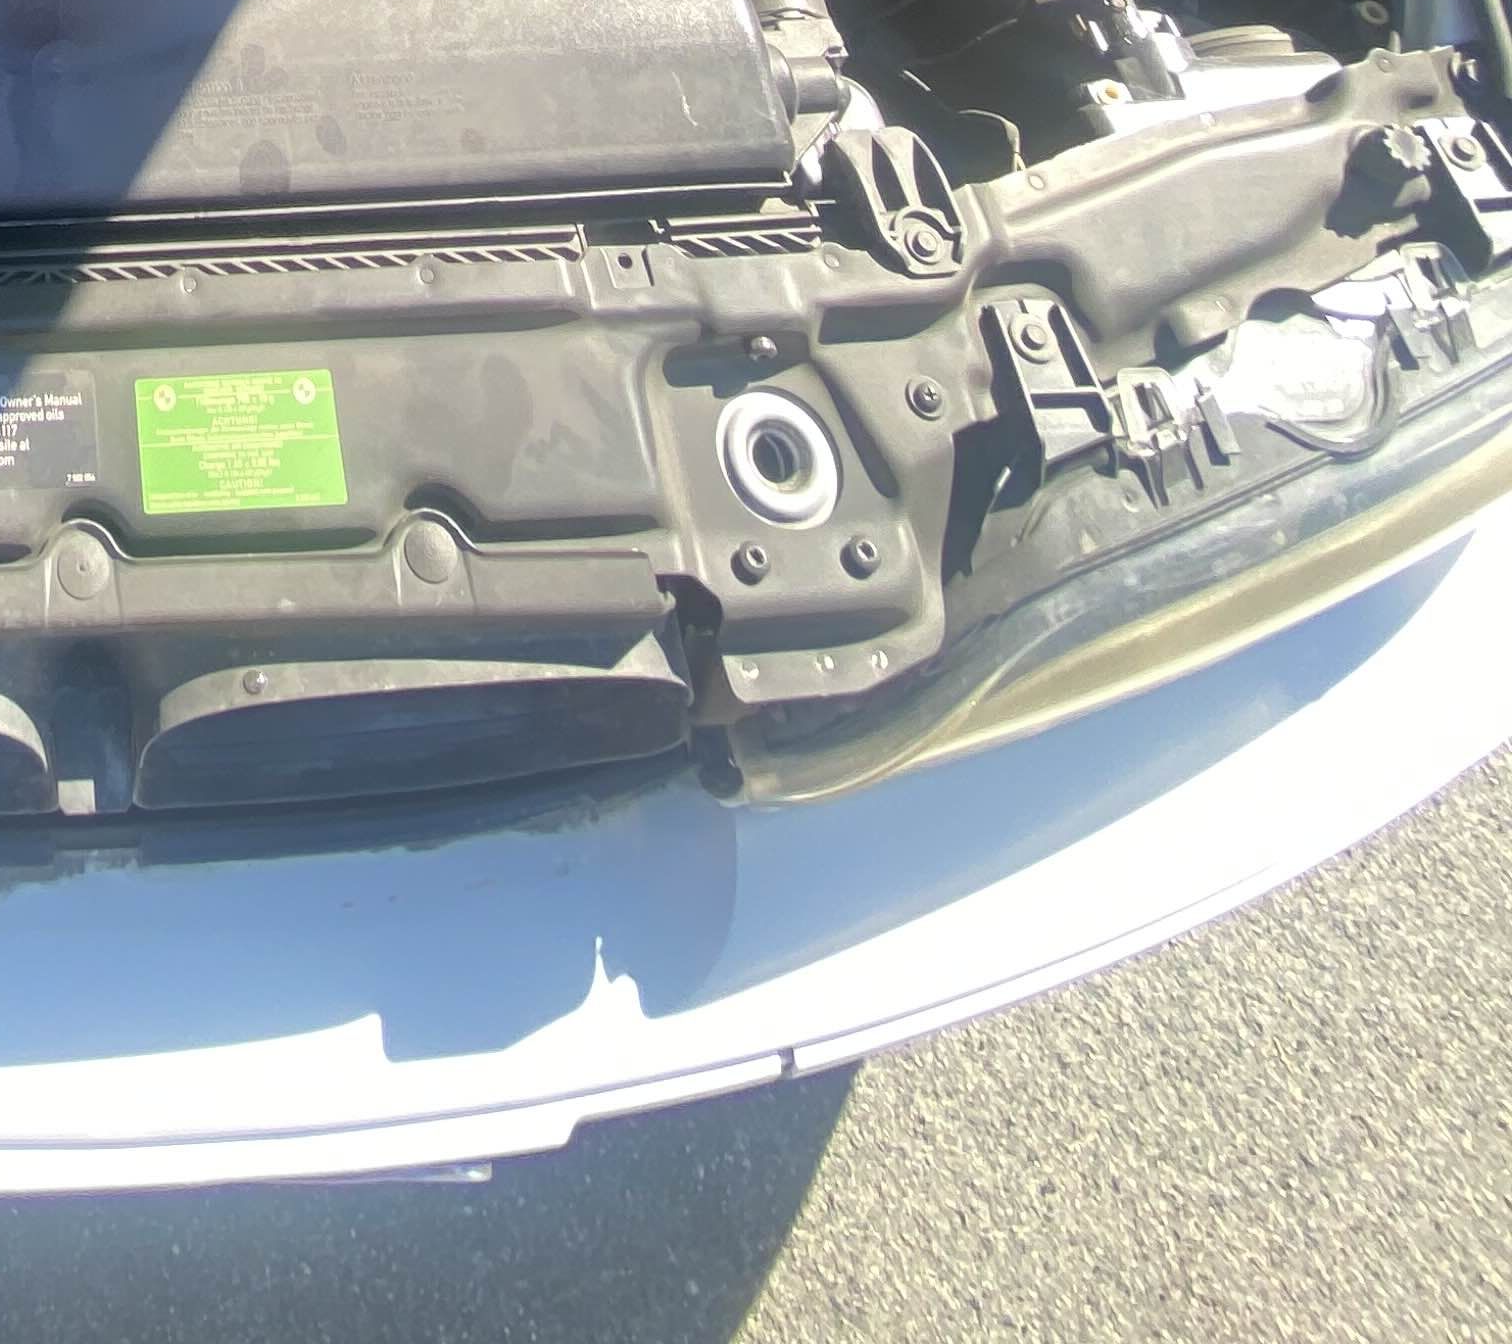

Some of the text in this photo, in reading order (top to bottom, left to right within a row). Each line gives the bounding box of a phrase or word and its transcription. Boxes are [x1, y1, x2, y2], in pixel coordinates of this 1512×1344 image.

[0, 394, 42, 408] Owner's
[44, 392, 82, 406] Manual
[45, 408, 65, 421] oils
[19, 438, 30, 451] at
